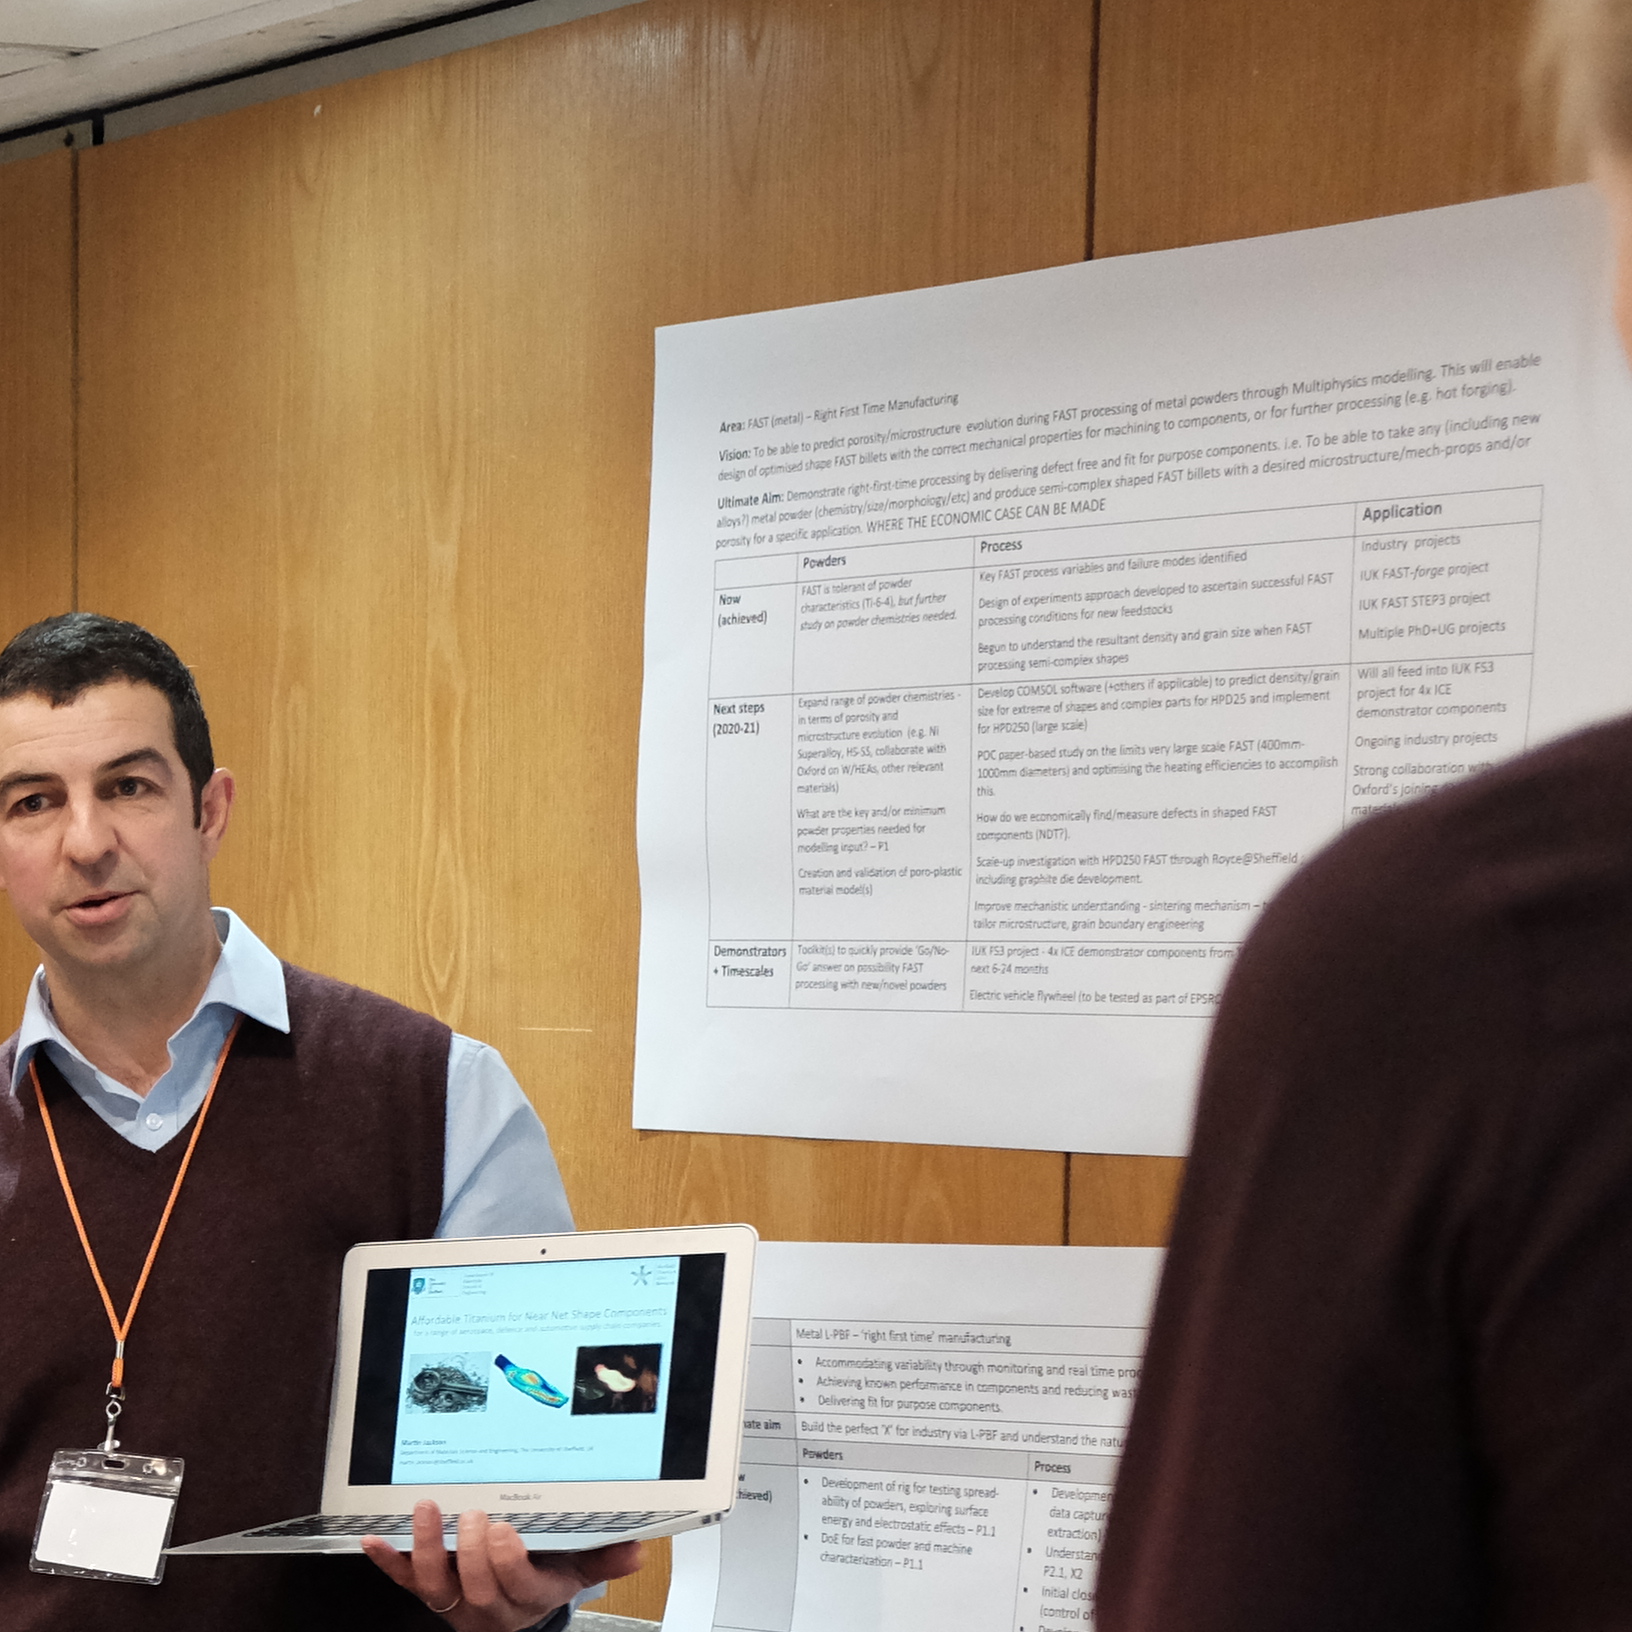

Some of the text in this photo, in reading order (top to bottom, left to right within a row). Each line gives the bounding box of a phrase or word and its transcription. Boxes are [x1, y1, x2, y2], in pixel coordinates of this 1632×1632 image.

[720, 394, 959, 432] Area: FAST (metal) Right First Time Manufacturing
[753, 446, 764, 457] To
[767, 446, 777, 455] be
[780, 443, 799, 454] able
[801, 442, 811, 451] to
[813, 437, 845, 451] predict
[847, 425, 961, 446] porosity/microstructure
[966, 418, 1013, 431] evolution
[1016, 414, 1049, 425] during
[1053, 408, 1077, 420] FAST
[1080, 404, 1138, 420] processing
[1140, 398, 1152, 411] of
[1155, 395, 1186, 409] metal
[1190, 391, 1238, 407] powders
[1242, 384, 1288, 399] through
[1292, 376, 1367, 393] Multiphysics
[1440, 363, 1466, 376] This
[1469, 359, 1492, 373] will
[1495, 354, 1541, 370] enable
[751, 511, 776, 523] metal
[778, 510, 812, 521] powder
[973, 488, 992, 501] and
[994, 487, 1036, 500] produce
[1039, 479, 1112, 494] semi-complex
[1115, 473, 1154, 487] shaped
[1157, 469, 1184, 482] FAST
[1187, 467, 1220, 480] billets
[1224, 464, 1248, 476] with
[1262, 457, 1305, 472] desired
[1309, 443, 1481, 467] microstructure/mech-props
[1485, 435, 1531, 451] and/or
[1362, 503, 1442, 522] Application
[715, 536, 751, 549] porosity
[776, 528, 808, 542] specific
[866, 518, 903, 532] WHERE
[907, 515, 927, 528] THE
[931, 509, 991, 526] ECONOMIC
[994, 506, 1022, 520] CASE
[1025, 504, 1049, 517] CAN
[1053, 502, 1066, 515] BE
[1070, 498, 1106, 512] MADE
[981, 540, 1022, 552] Process
[1362, 535, 1461, 551] Industry projects
[803, 555, 846, 568] Powders
[1361, 569, 1379, 581] IUK
[1447, 562, 1489, 576] project
[719, 594, 741, 605] Now
[1360, 592, 1490, 610] IUK FAST STEP3 project
[718, 611, 767, 626] (achieved)
[1359, 621, 1506, 639] Multiple PhD+UG projects
[1358, 661, 1494, 678] Will all feed into IUK FS3
[1357, 687, 1396, 700] project
[1434, 683, 1452, 695] ICE
[714, 703, 765, 715] Next steps
[1357, 703, 1506, 718] demonstrator components
[714, 722, 759, 736] (2020-21)
[1355, 732, 1497, 749] Ongoing industry projects
[714, 945, 786, 956] Demonstrators
[721, 965, 773, 976] Timescales
